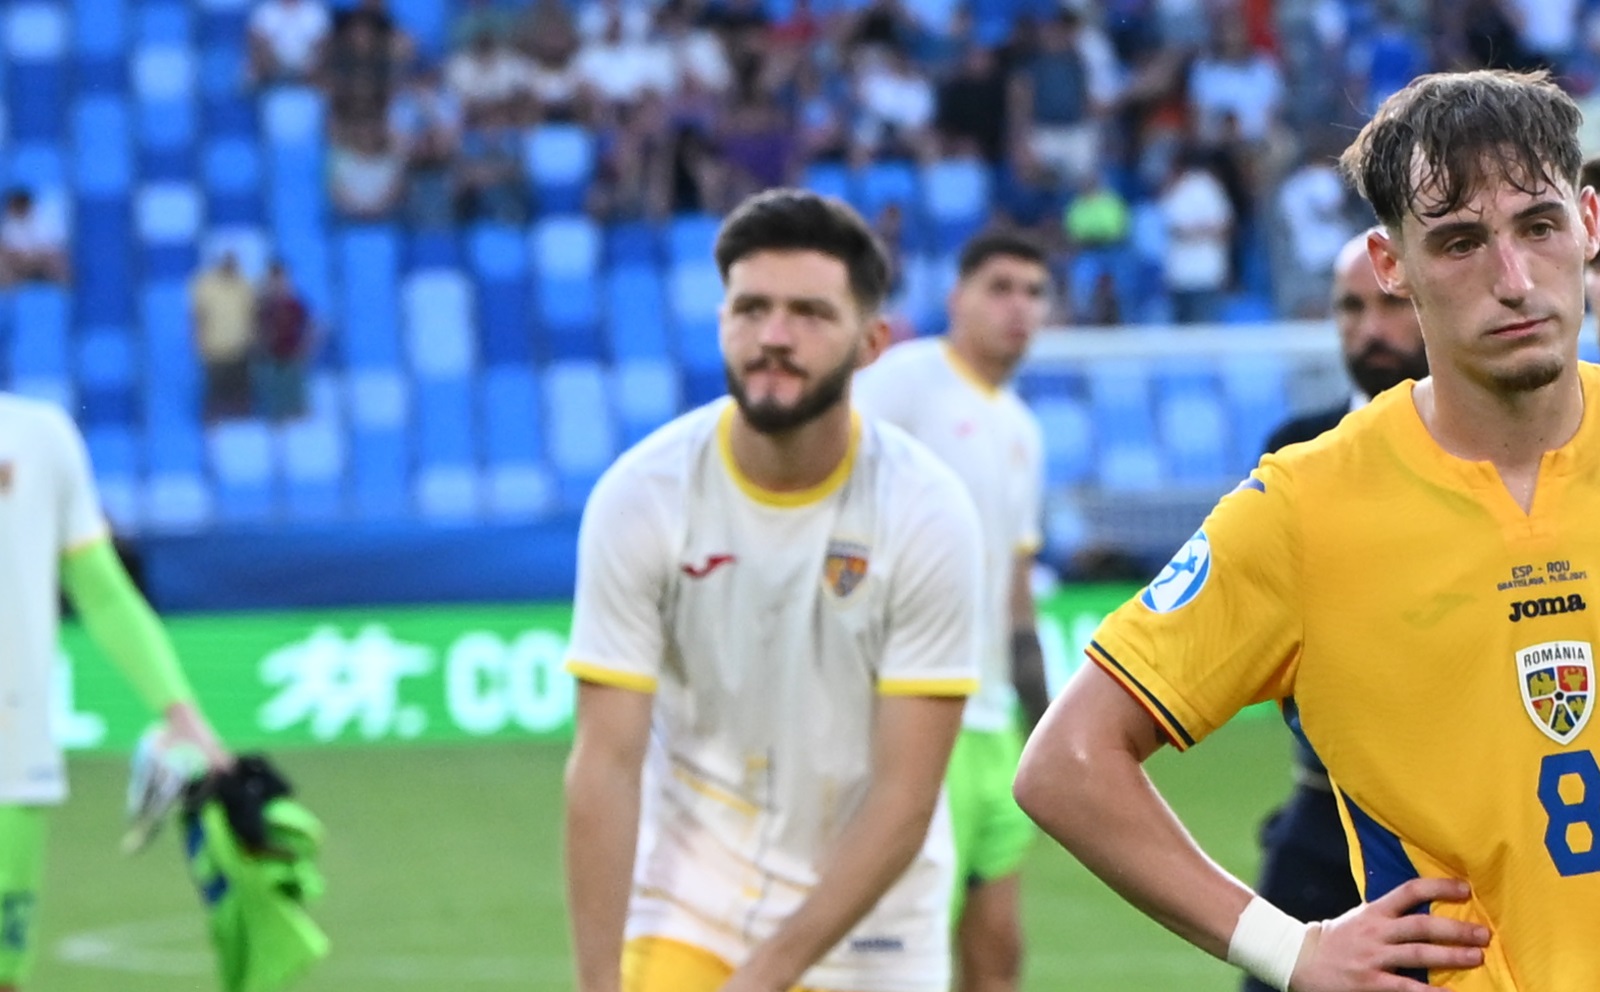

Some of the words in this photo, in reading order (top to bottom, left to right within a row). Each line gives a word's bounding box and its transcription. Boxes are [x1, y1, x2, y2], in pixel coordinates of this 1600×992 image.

[1511, 564, 1533, 579] ESP
[1546, 560, 1570, 573] ROU
[1523, 642, 1585, 668] ROMÂNIA
